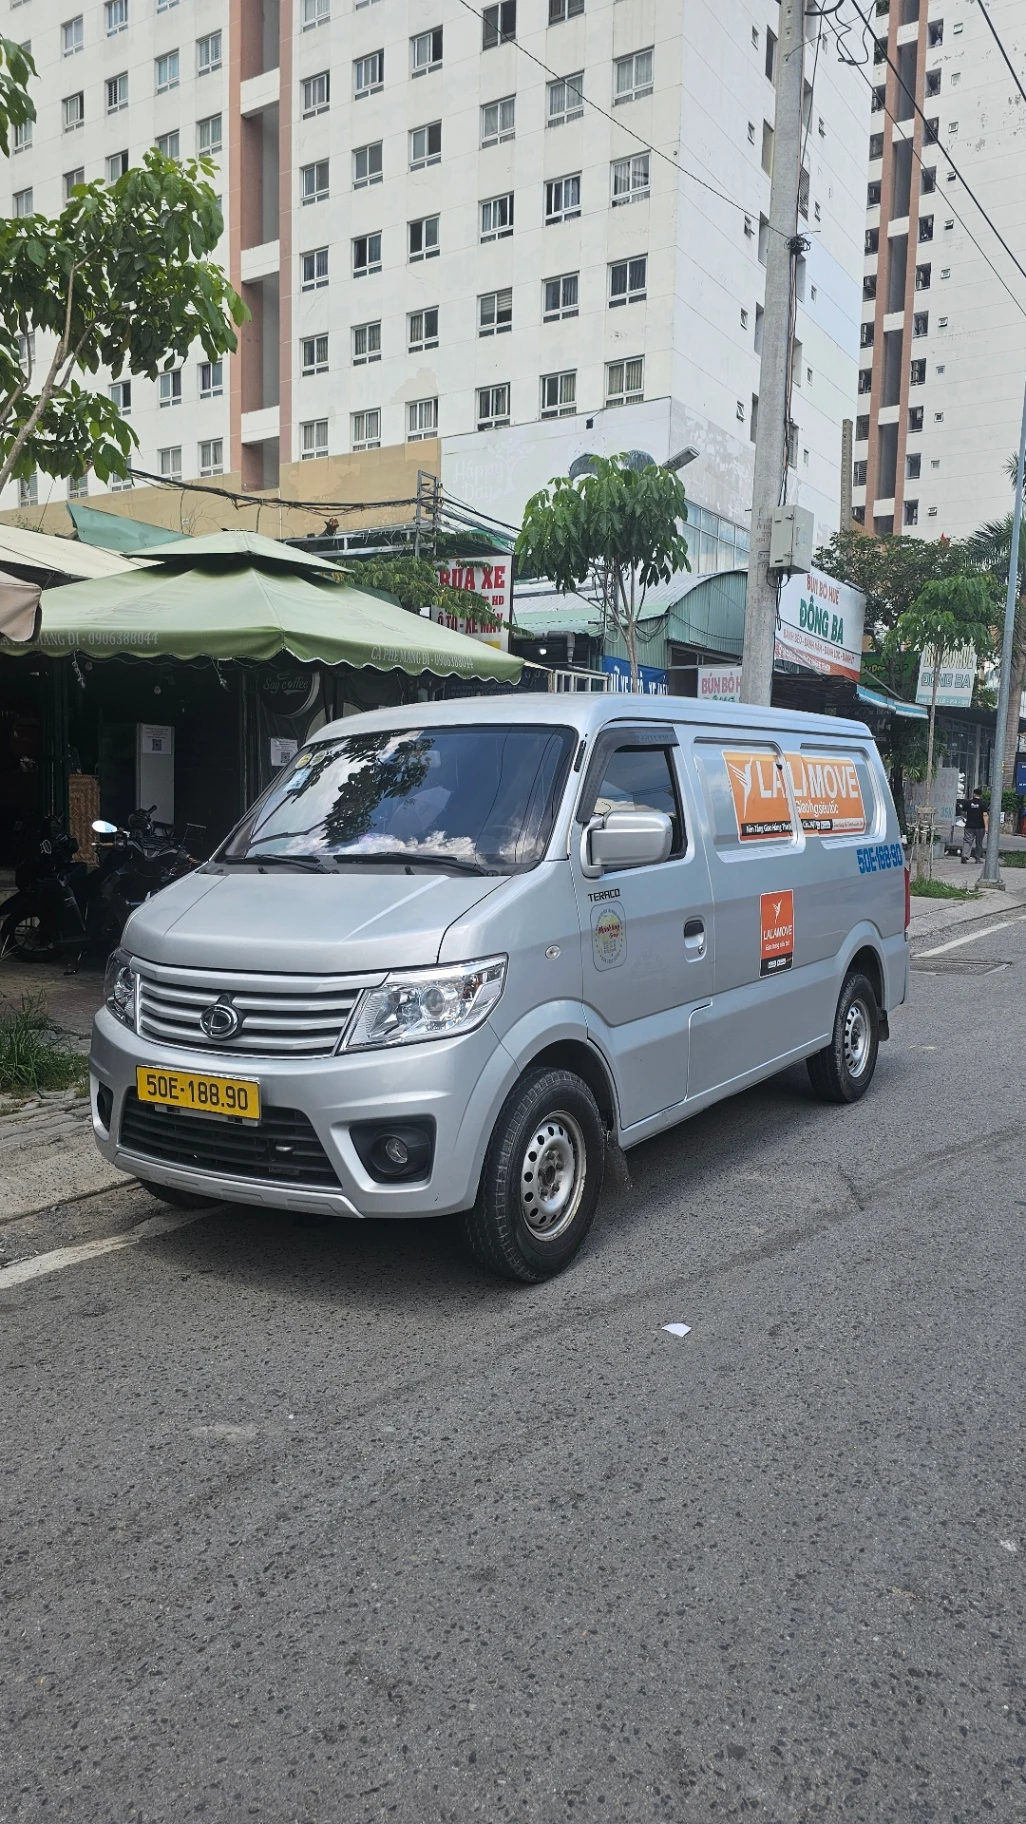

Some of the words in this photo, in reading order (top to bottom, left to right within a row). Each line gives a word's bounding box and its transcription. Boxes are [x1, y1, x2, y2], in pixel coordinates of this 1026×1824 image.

[461, 482, 493, 506] Day
[481, 565, 506, 590] XE
[799, 594, 829, 639] ĐÔNG
[830, 613, 844, 645] BA
[88, 631, 159, 645] 0906388044
[371, 644, 384, 660] CÀ
[400, 650, 421, 665] MANG
[263, 677, 280, 695] Say
[281, 676, 309, 690] coffee
[701, 672, 720, 695] BÚN
[721, 671, 735, 693] BÒ
[954, 673, 971, 689] BA
[587, 888, 621, 902] TERACO
[763, 924, 793, 941] LALAMOVE
